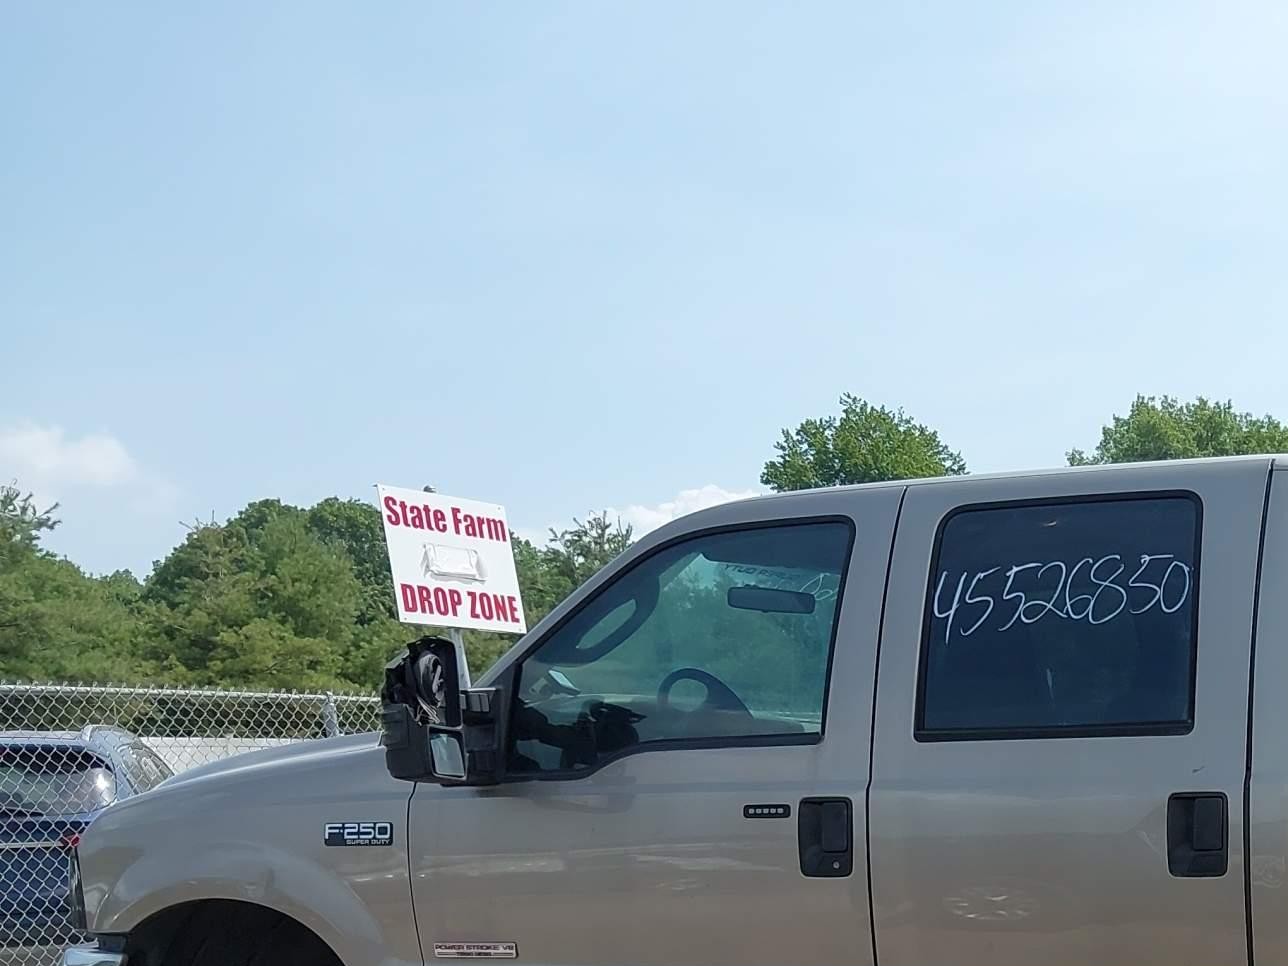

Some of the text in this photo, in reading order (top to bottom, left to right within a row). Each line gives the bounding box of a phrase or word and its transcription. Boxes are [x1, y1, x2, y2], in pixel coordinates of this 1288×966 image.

[383, 496, 508, 542] State Farm
[400, 583, 521, 623] DROP ZONE
[933, 554, 1194, 645] 45526850
